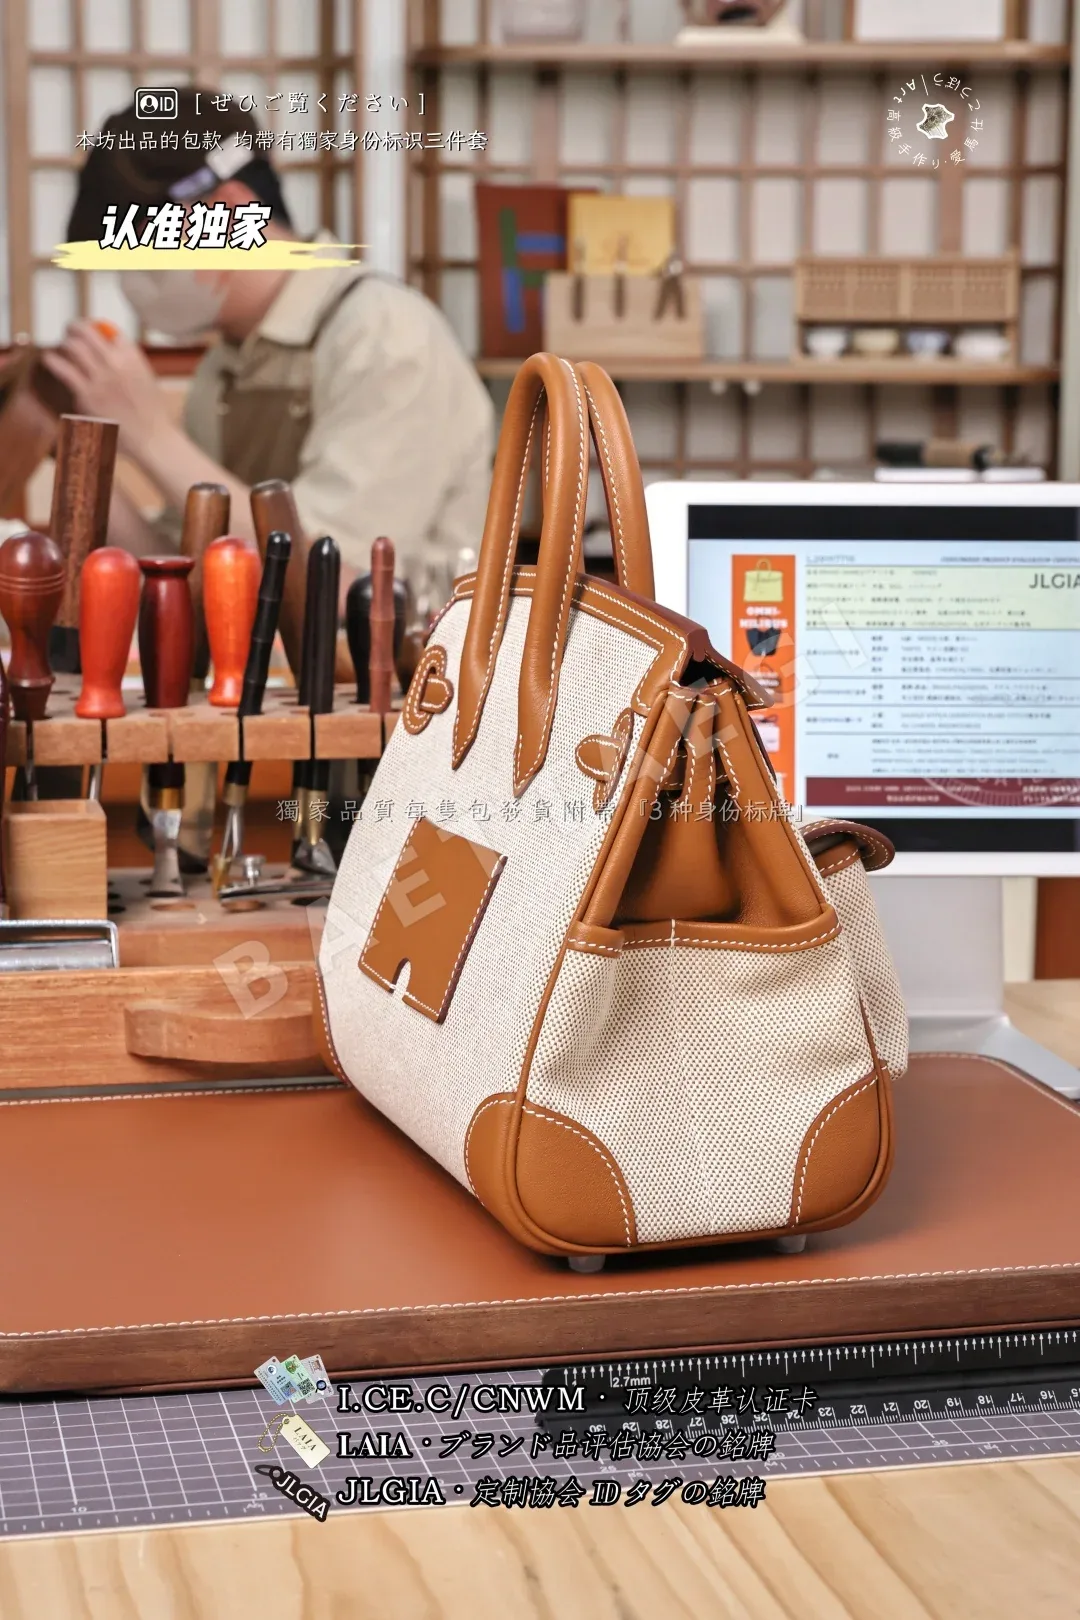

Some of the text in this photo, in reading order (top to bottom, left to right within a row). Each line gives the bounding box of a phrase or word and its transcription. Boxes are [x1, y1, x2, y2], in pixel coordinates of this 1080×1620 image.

[612, 1376, 651, 1388] 2.7mm
[622, 1422, 637, 1432] 29
[655, 1419, 671, 1430] 28
[689, 1417, 704, 1427] 27
[721, 1414, 736, 1425] 26
[818, 1406, 833, 1417] 23
[850, 1404, 865, 1415] 22
[883, 1402, 898, 1412] 21
[914, 1400, 929, 1410] 20
[946, 1397, 961, 1407] 19
[978, 1395, 993, 1405] 18
[1010, 1392, 1025, 1403] 17
[1040, 1390, 1055, 1400] 16
